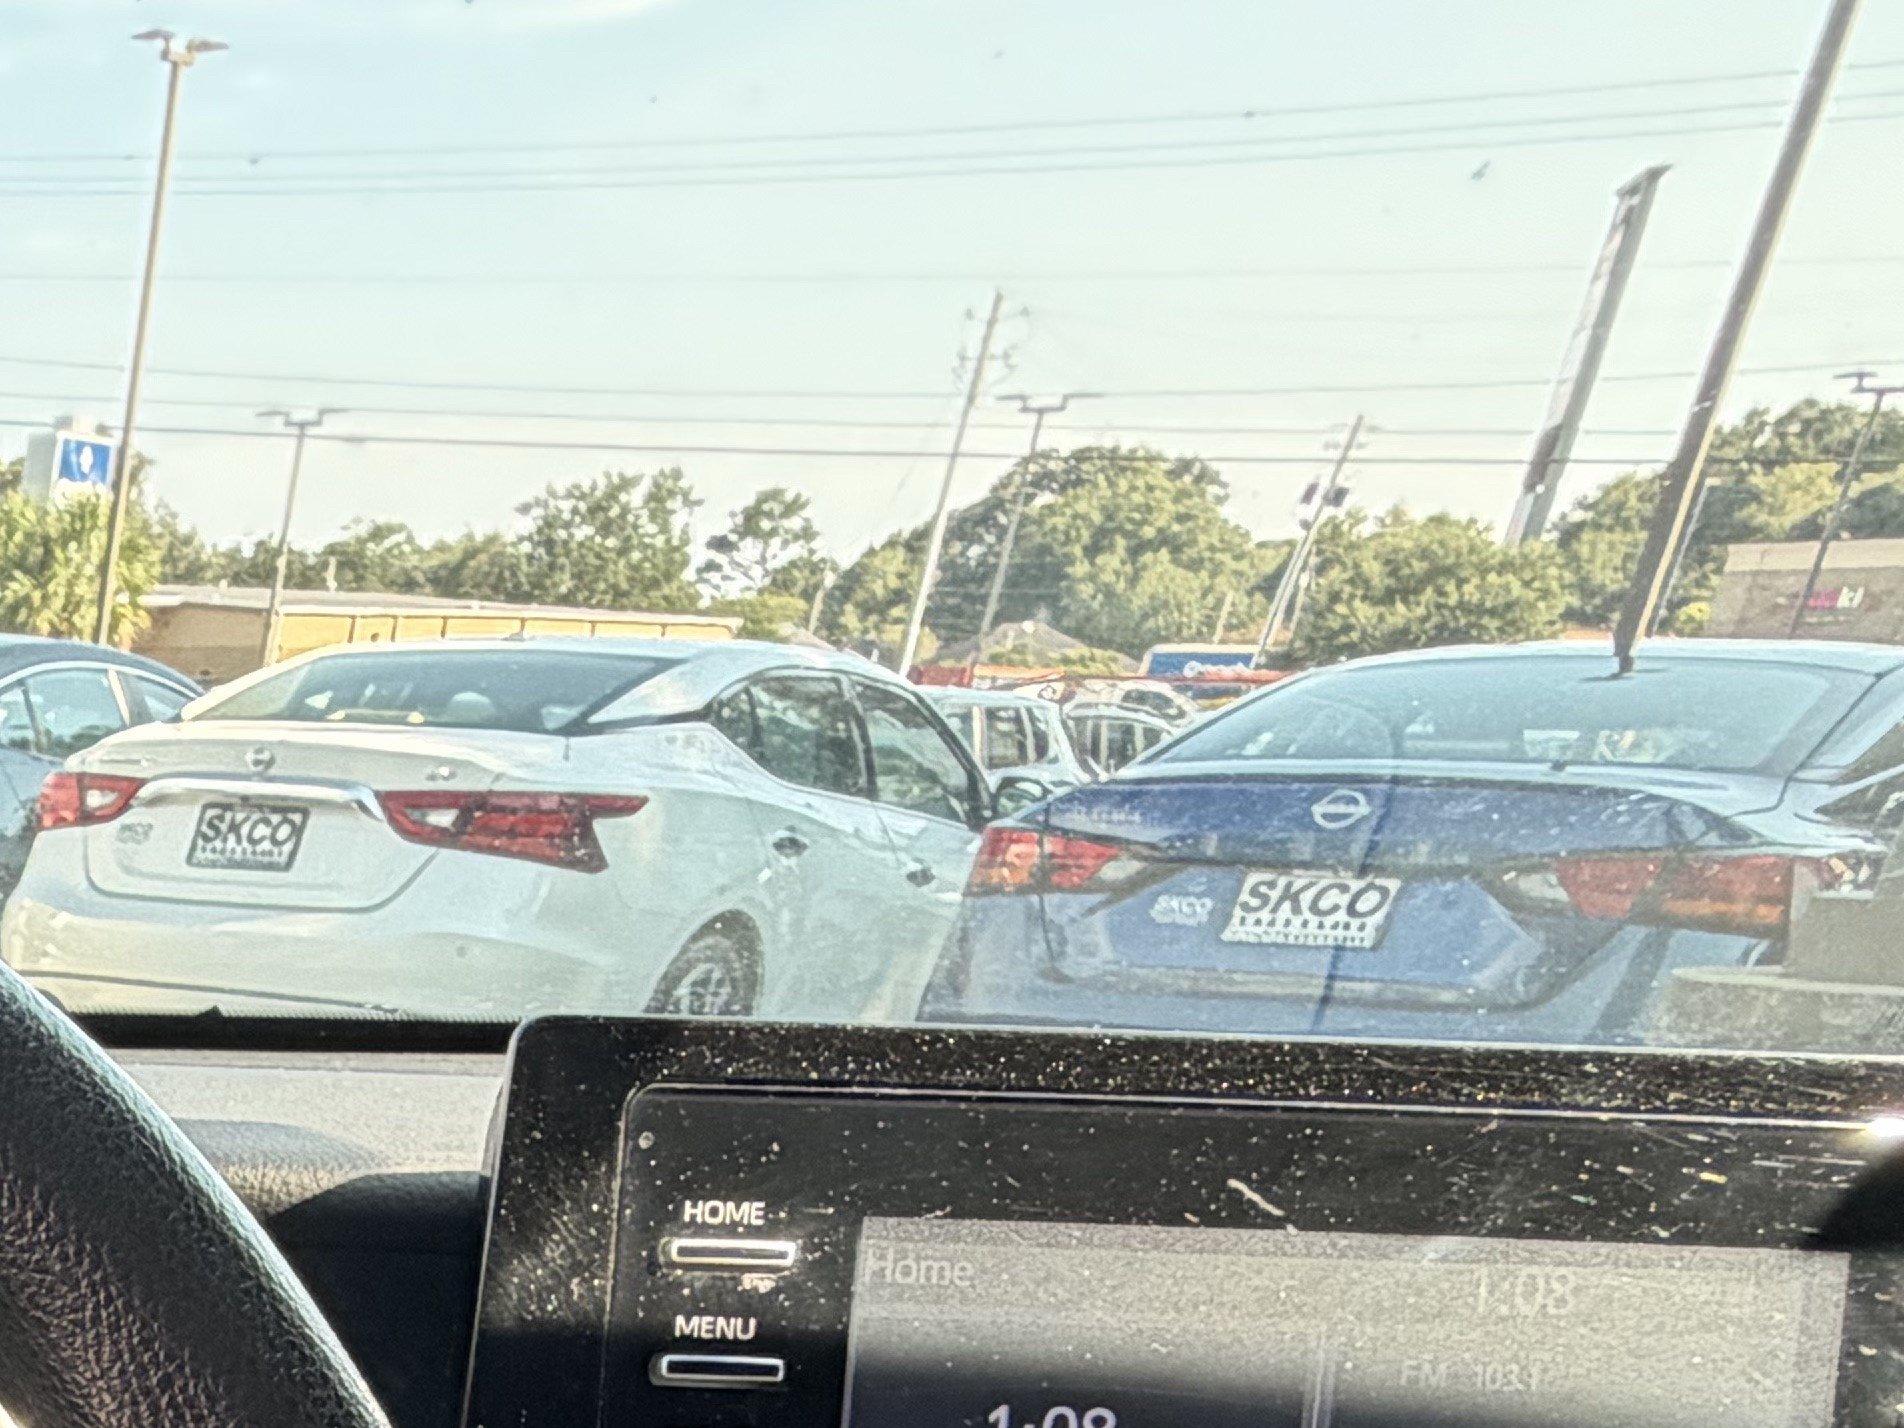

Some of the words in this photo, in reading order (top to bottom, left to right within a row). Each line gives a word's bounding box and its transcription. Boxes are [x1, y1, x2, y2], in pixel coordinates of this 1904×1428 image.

[200, 814, 293, 848] SKCO
[1240, 878, 1391, 918] SKCO
[683, 1200, 765, 1225] HOME
[863, 1248, 973, 1289] Home
[675, 1314, 756, 1340] MENU
